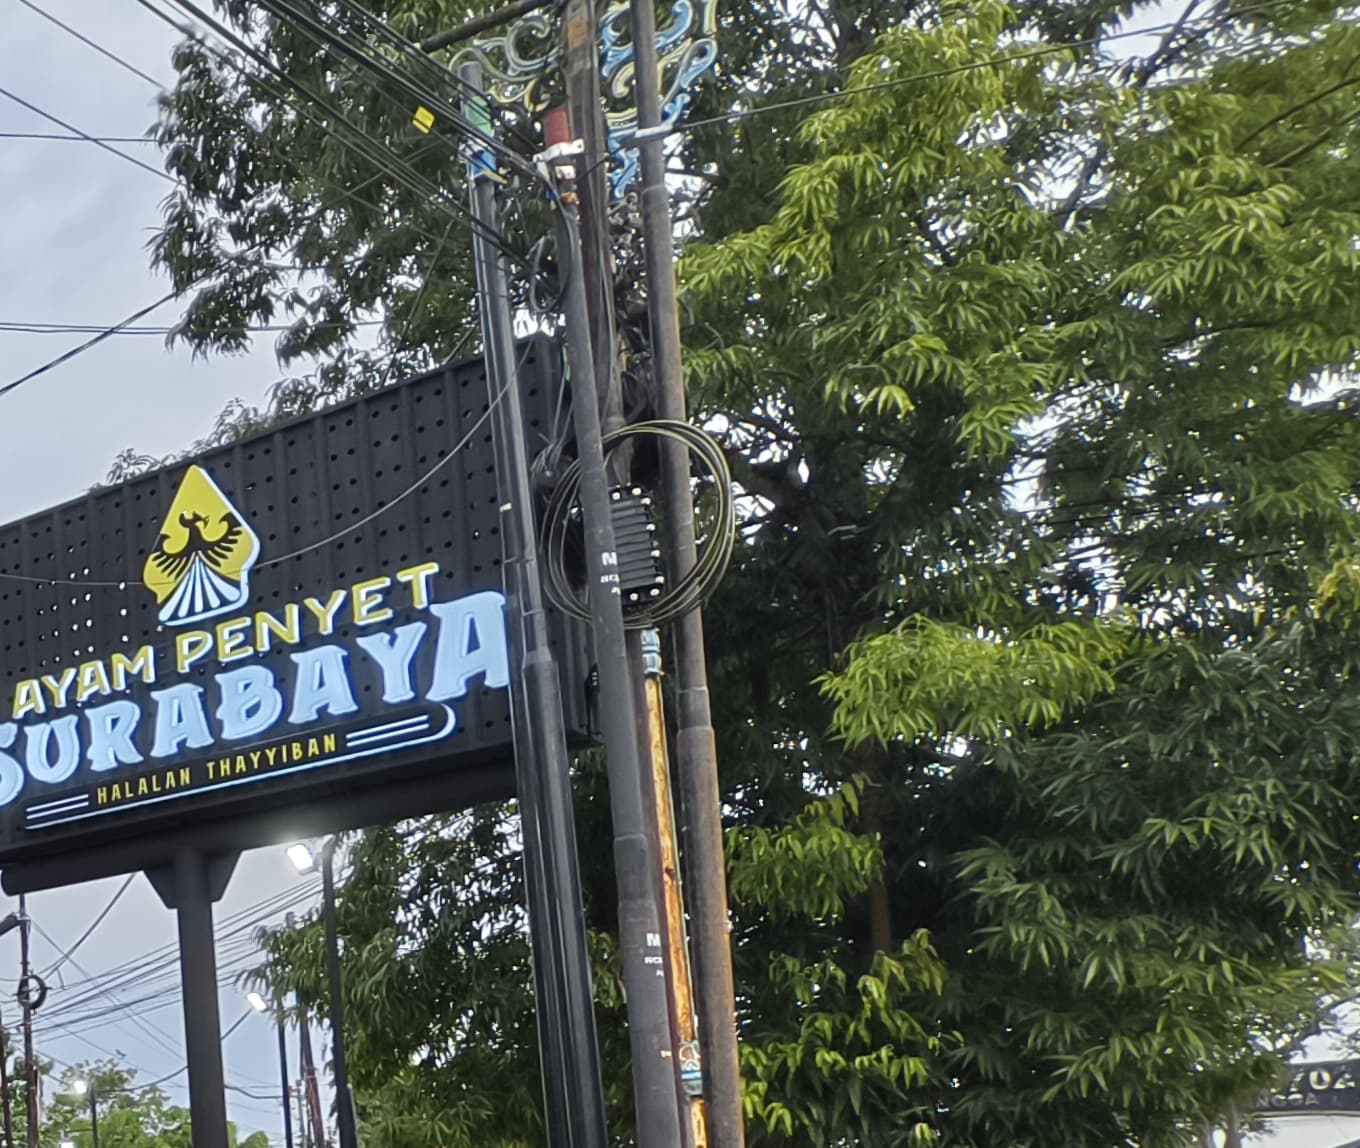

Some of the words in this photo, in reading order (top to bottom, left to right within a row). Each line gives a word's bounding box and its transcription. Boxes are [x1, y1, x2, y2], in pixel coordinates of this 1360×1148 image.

[12, 645, 155, 720] AYAM
[177, 562, 441, 673] PENYET
[97, 768, 191, 805] HALALAN
[206, 733, 337, 778] THAYYIBAN
